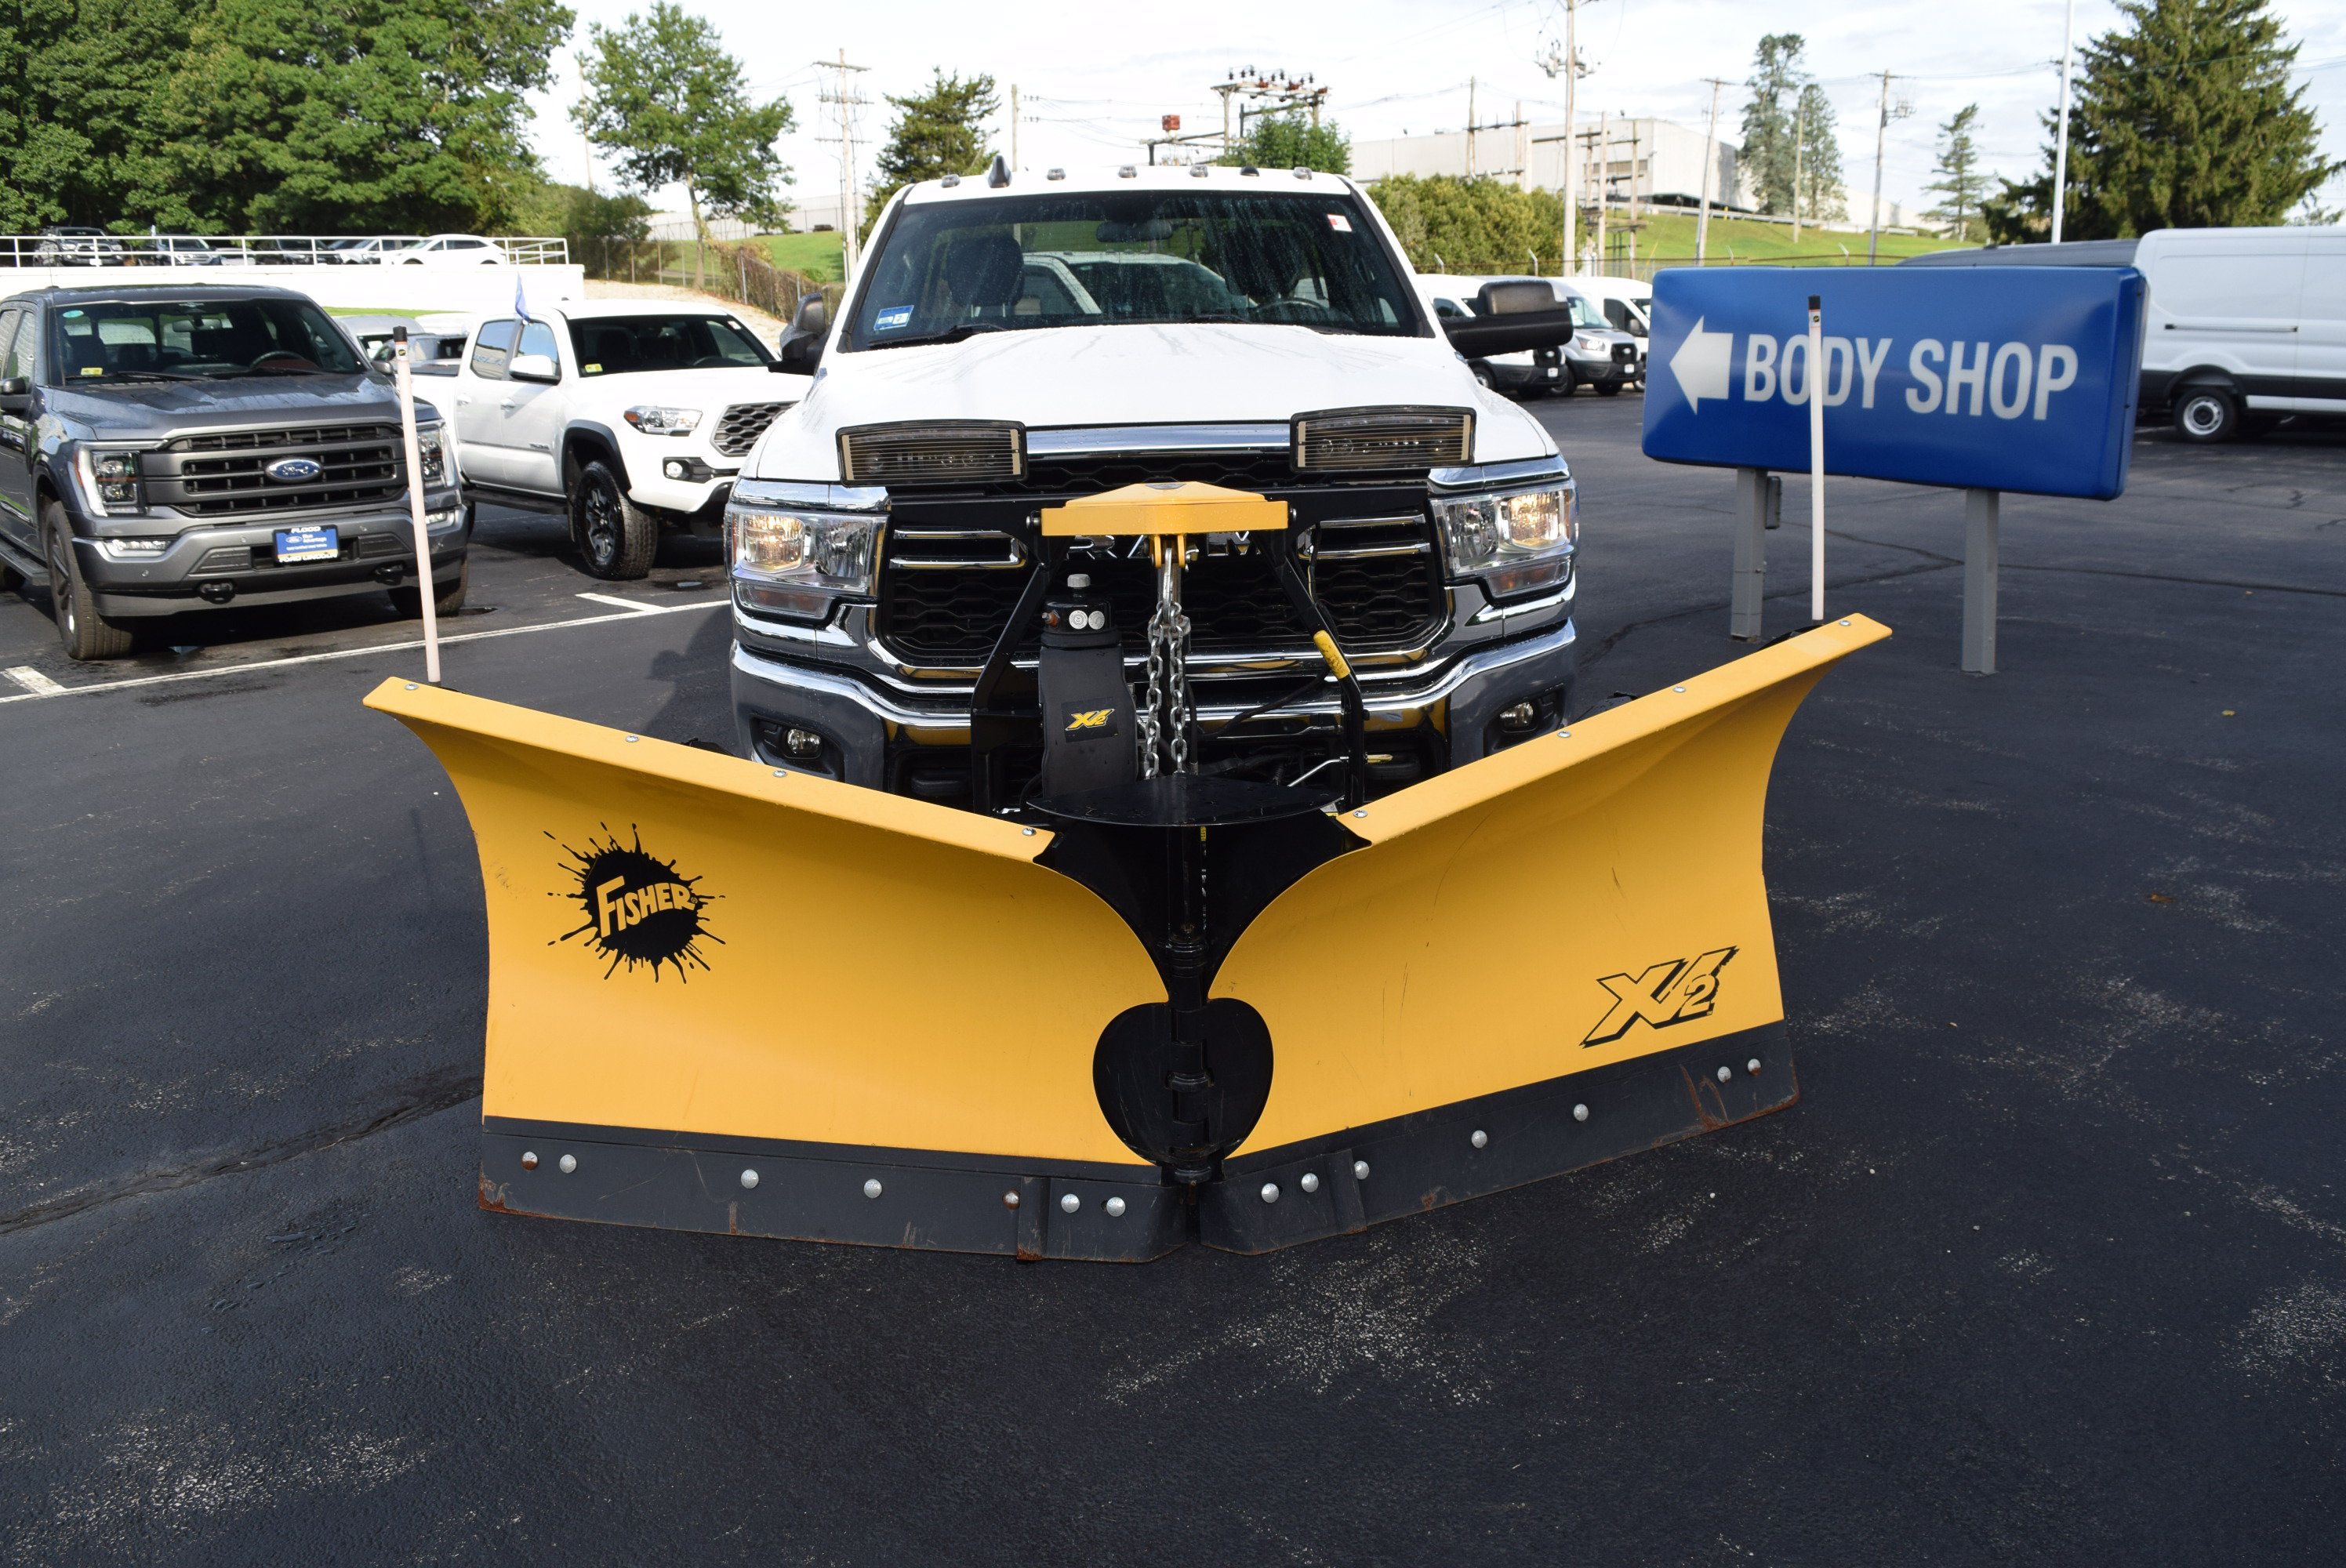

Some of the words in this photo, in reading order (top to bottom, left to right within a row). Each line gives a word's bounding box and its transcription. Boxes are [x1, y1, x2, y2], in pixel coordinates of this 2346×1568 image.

[1744, 334, 1894, 409] BODY
[1905, 338, 2079, 420] SHOP
[596, 875, 695, 939] FISHER
